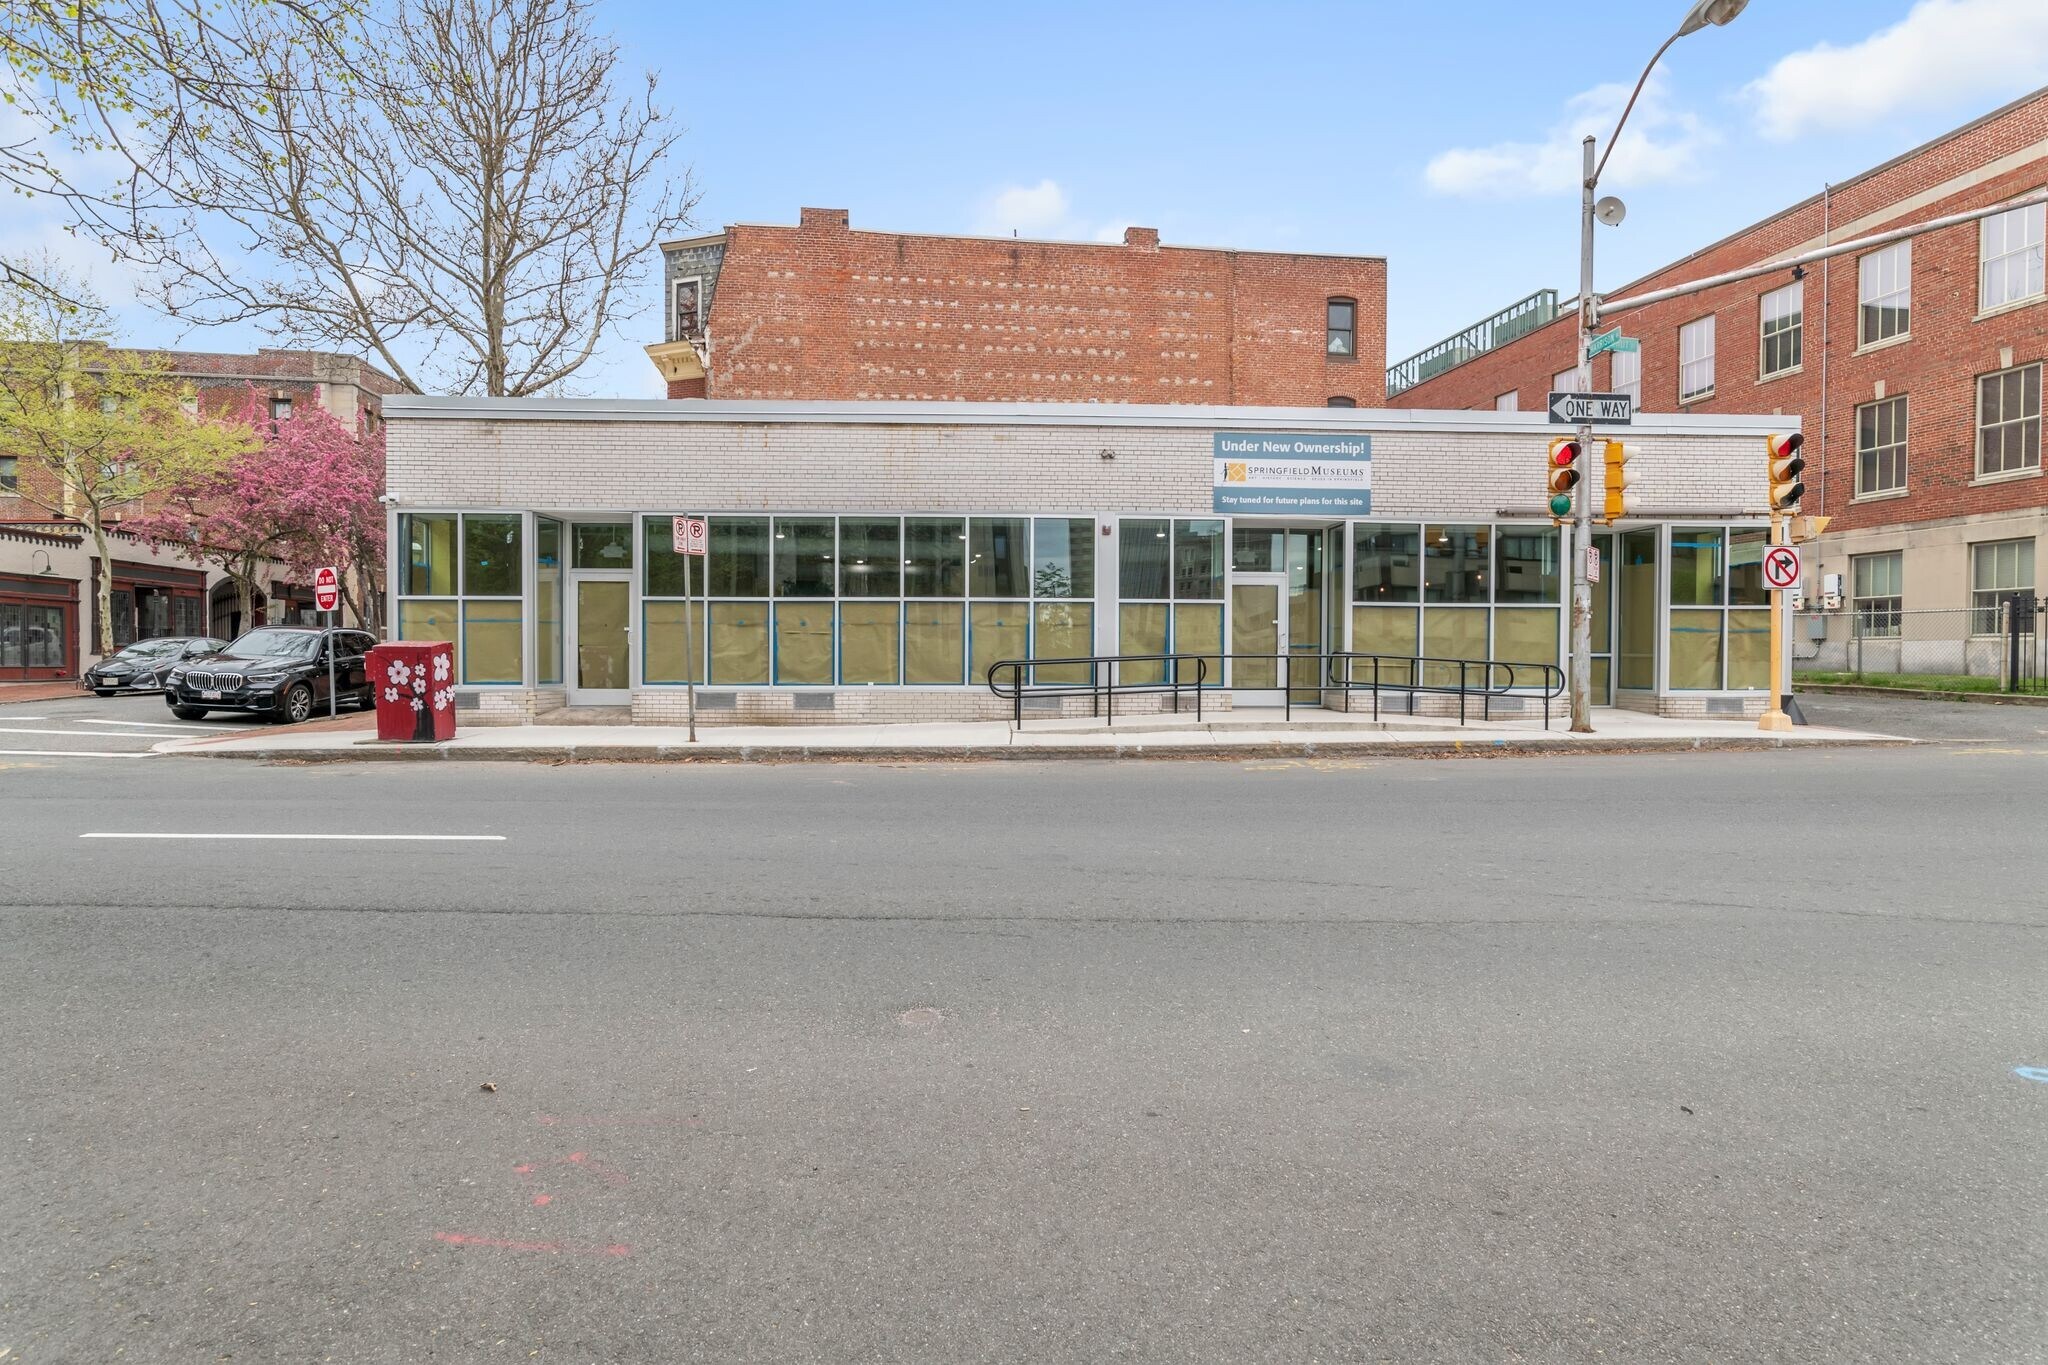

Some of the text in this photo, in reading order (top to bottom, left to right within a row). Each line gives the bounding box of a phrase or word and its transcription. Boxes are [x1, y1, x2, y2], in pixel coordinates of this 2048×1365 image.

[1565, 400, 1628, 418] ONE WAY
[1221, 440, 1365, 457] Under New Ownership!
[1248, 465, 1364, 477] SPRINGFIELD MUSEUMS
[1221, 495, 1364, 507] Stay tuned for future plans for this site
